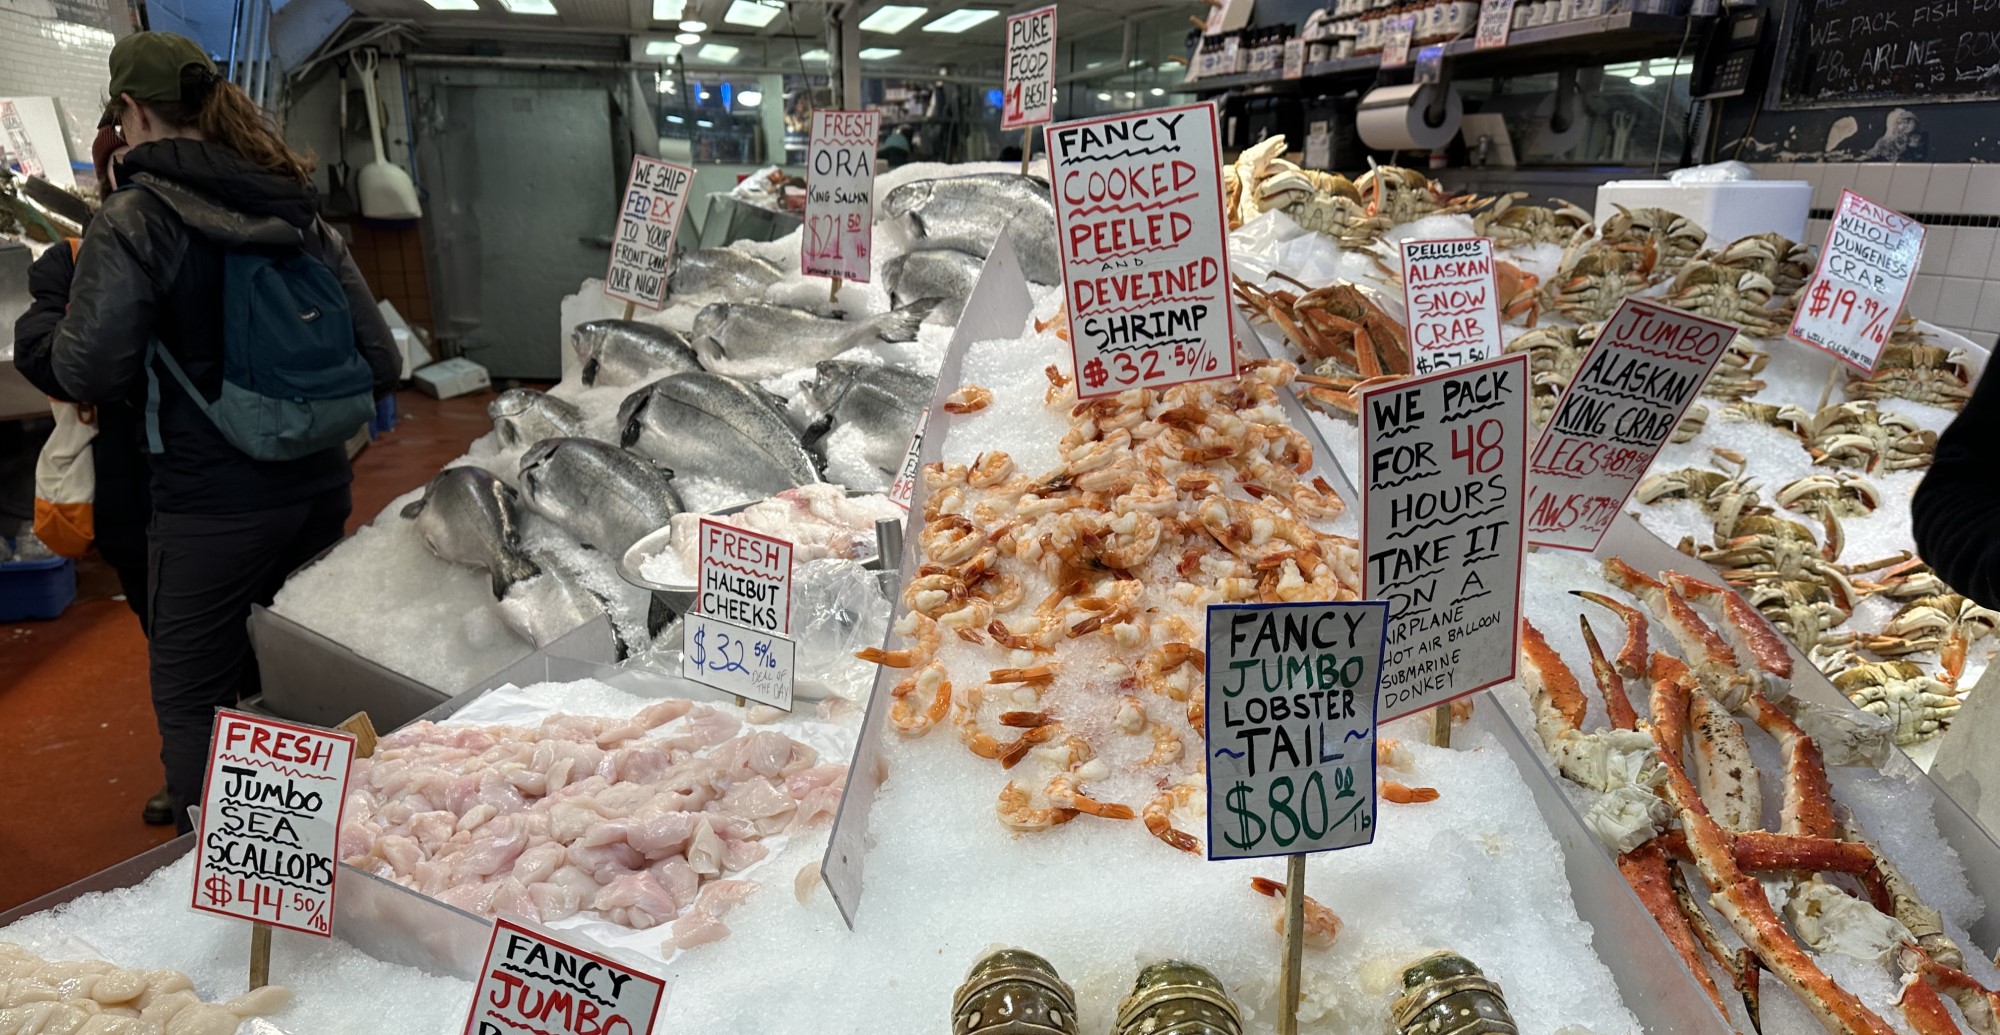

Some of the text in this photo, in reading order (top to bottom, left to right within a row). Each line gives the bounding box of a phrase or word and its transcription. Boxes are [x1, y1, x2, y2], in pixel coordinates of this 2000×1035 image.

[1012, 14, 1050, 45] PURE
[1810, 0, 2000, 47] WE PACK FISH FO
[1010, 52, 1048, 76] FOOD
[1858, 39, 1942, 75] AIRLINE
[1006, 80, 1049, 121] #1 BEST
[824, 113, 873, 137] FRESH
[1058, 114, 1184, 157] FANCY
[634, 160, 686, 191] WE SHIP
[815, 149, 870, 178] ORA
[1064, 160, 1196, 205] COOKED
[808, 184, 830, 205] KING
[1851, 197, 1911, 231] FANCY
[623, 219, 672, 249] TO YOUR
[1070, 212, 1192, 257] PEELED
[1407, 240, 1481, 257] DELICIOUS
[615, 244, 650, 266] FRONT
[1101, 258, 1144, 272] AND
[1409, 256, 1490, 284] ALASKAN
[1829, 255, 1886, 292] CRAB
[1833, 232, 1908, 279] DUNGENESS
[609, 266, 665, 296] OVER NIGHT
[1073, 256, 1218, 313] DEVEINED
[1413, 286, 1486, 312] SNOW
[1084, 305, 1208, 350] SHRIMP
[1414, 318, 1485, 347] CRAB
[1616, 307, 1720, 357] JUMBO
[1581, 349, 1699, 406] ALASKAN
[1373, 371, 1512, 431] WE PACK
[1555, 392, 1675, 440] KING CRAB
[1373, 419, 1503, 483] FOR 48
[1531, 434, 1608, 475] LEGS
[1391, 474, 1507, 528] HOURS
[1528, 486, 1584, 528] AWS
[710, 528, 780, 571] FRESH
[1368, 521, 1509, 585] TAKE IT
[706, 567, 780, 606] HALIBUT
[1460, 570, 1484, 595] A
[703, 592, 778, 630] CHEEKS
[1386, 605, 1464, 645] IRPLANE
[1231, 611, 1366, 657] FANCY
[1383, 611, 1501, 672] HOT AIR BALLOON
[752, 670, 772, 685] DEAL
[757, 682, 771, 694] THE
[1223, 653, 1364, 697] JUMBO
[1381, 649, 1462, 690] SUBMARINE
[1385, 668, 1455, 709] DONKEY
[1224, 690, 1355, 728] LOBSTER
[226, 722, 333, 771] FRESH
[1236, 722, 1344, 777] TAIL
[220, 806, 299, 841] SEA
[207, 833, 333, 886] SCALLOPS
[506, 934, 633, 999] FANCY
[489, 969, 633, 1035] JUMBO
